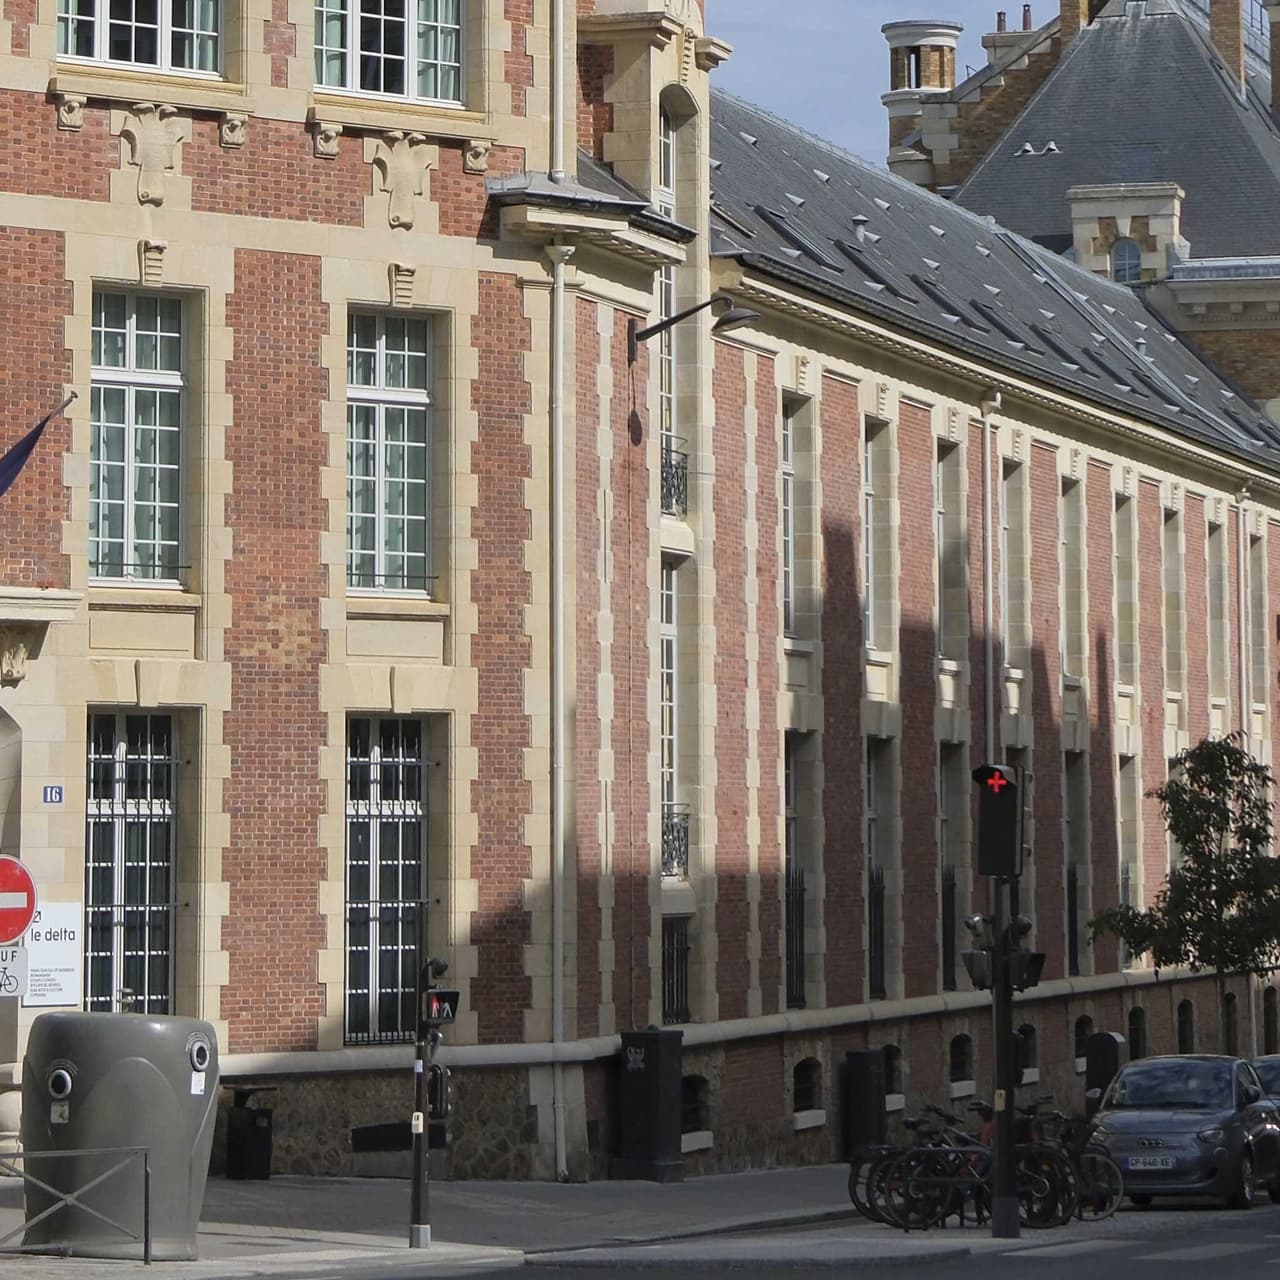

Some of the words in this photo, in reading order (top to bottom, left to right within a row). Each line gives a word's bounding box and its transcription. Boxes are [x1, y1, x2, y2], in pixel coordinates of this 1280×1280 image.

[46, 787, 60, 802] 16
[31, 928, 41, 942] le
[44, 927, 76, 942] delta
